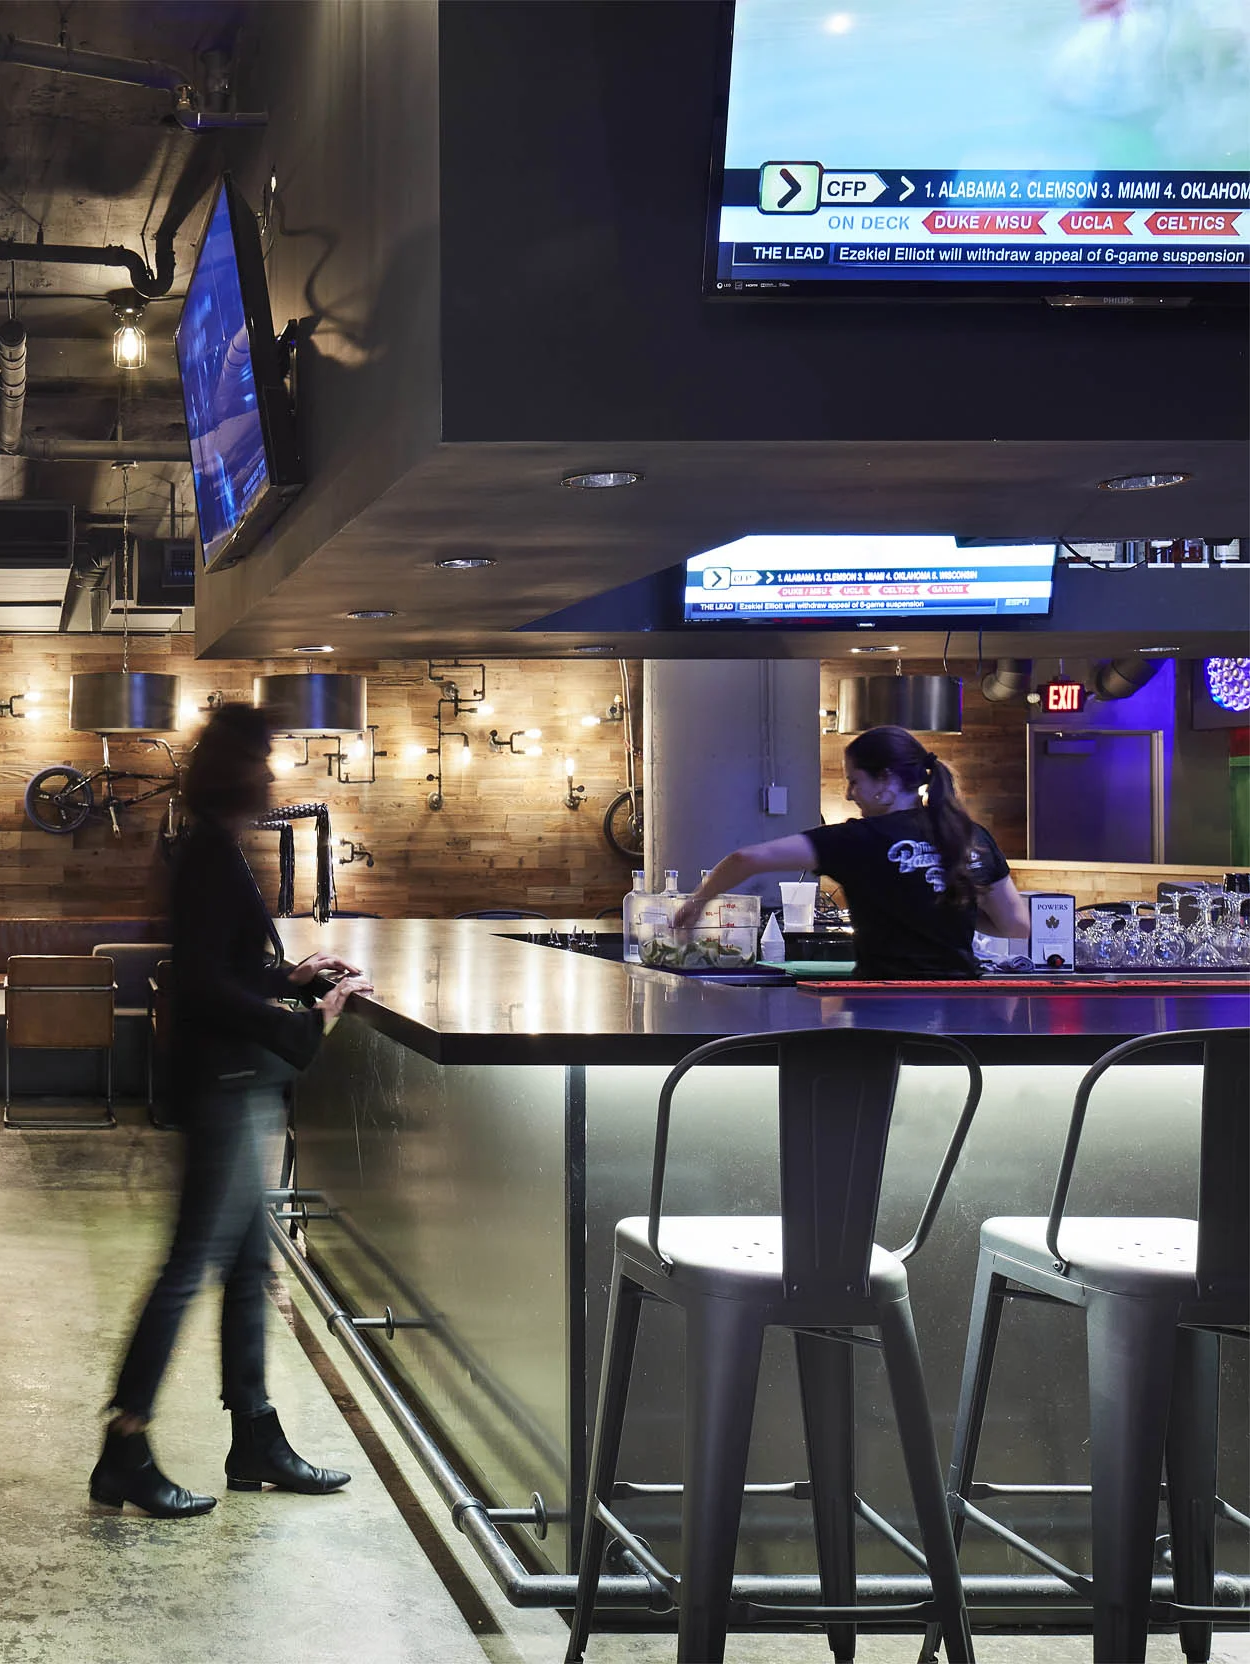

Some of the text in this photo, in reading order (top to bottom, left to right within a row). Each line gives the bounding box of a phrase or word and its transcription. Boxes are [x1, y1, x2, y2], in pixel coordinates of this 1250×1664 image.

[827, 181, 867, 197] CFP
[925, 181, 935, 198] 1.
[938, 181, 1006, 199] ALABAMA
[1010, 182, 1022, 199] 2.
[1027, 181, 1098, 199] CLEMSON
[1101, 182, 1114, 199] 3.
[1118, 182, 1160, 199] MIAMI
[1164, 182, 1176, 199] 4.
[828, 216, 910, 230] ON DECK
[934, 215, 979, 229] DUKE
[995, 216, 1033, 230] MSU
[1070, 216, 1114, 230] UCLA
[1156, 216, 1225, 230] CELTICS
[753, 247, 824, 260] THE LEAD
[839, 247, 1245, 265] Ezekiel Elliott will withdraw appeal of 6-game suspension
[700, 603, 715, 611] THE
[739, 602, 763, 610] Ezekiel
[886, 600, 925, 609] suspension
[1049, 685, 1080, 709] EXIT
